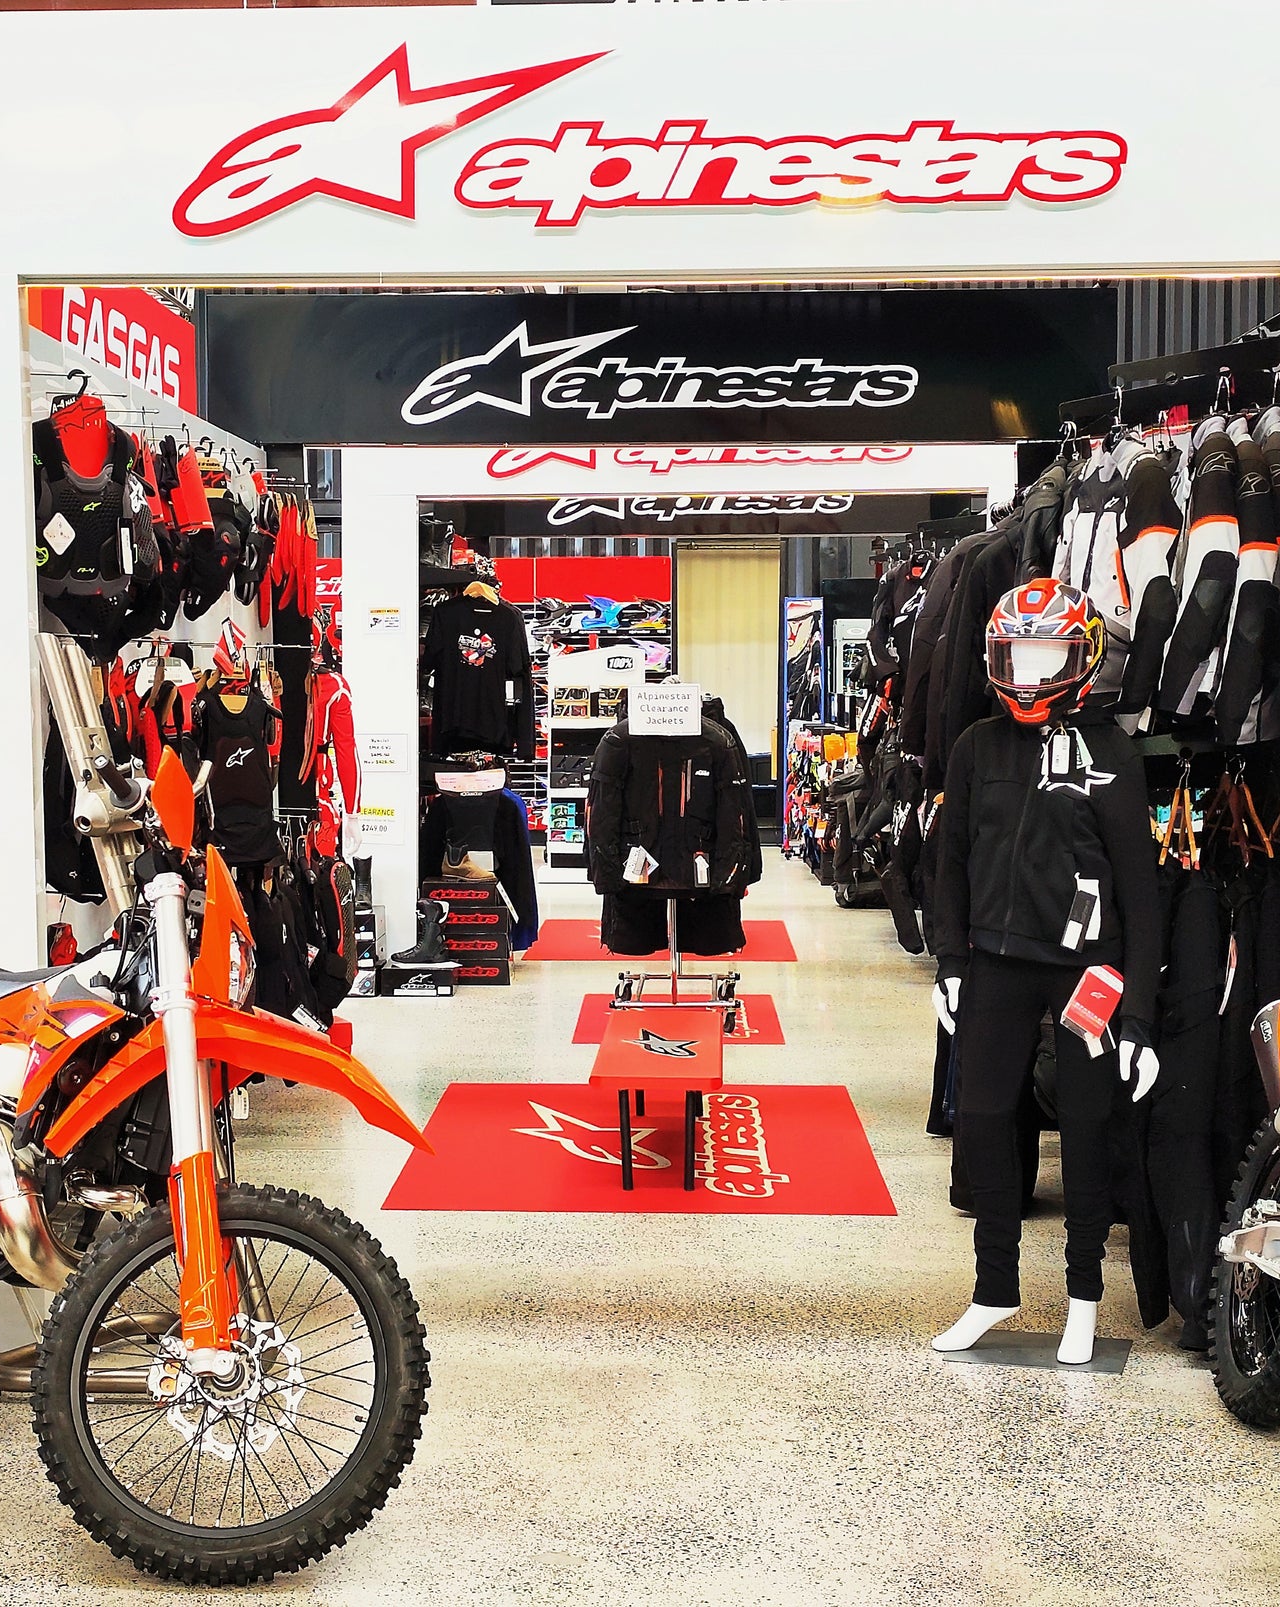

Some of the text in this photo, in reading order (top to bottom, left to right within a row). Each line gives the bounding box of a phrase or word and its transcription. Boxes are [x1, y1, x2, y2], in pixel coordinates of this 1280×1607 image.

[454, 120, 1130, 229] alpinestars
[61, 287, 180, 408] GASGAS
[541, 358, 918, 419] alpinestars
[608, 656, 633, 669] 100%
[637, 692, 692, 703] Alpinestar
[639, 704, 689, 713] Clearance
[646, 717, 684, 725] Jackets
[360, 807, 396, 817] LEARANCE
[429, 889, 489, 899] alpinestars
[1260, 1020, 1272, 1043] KTM
[694, 1092, 790, 1198] alpinestars
